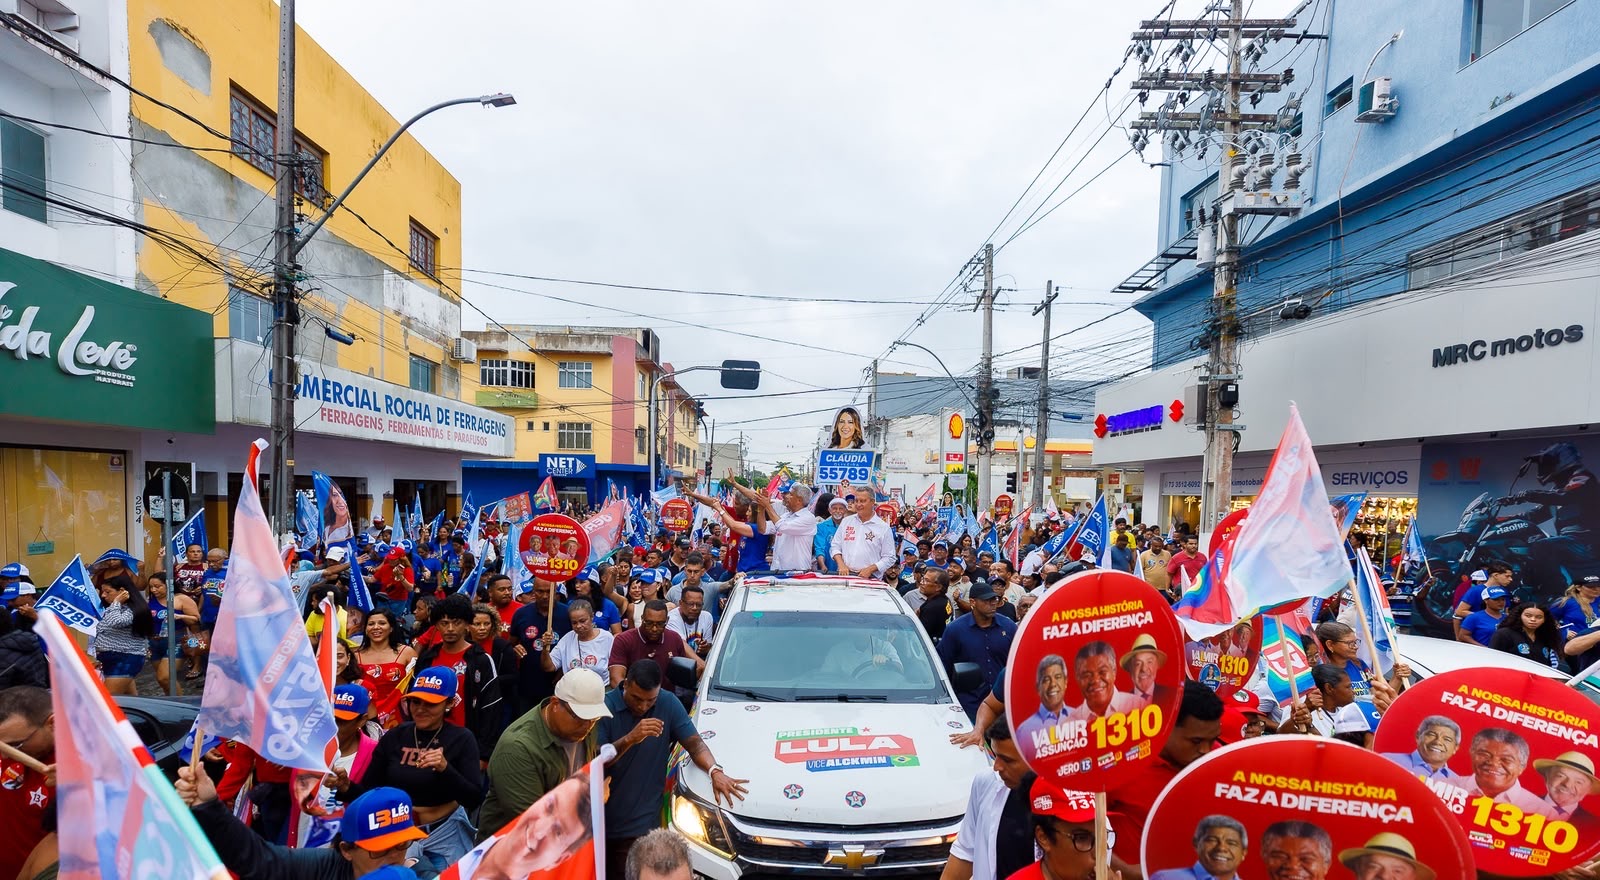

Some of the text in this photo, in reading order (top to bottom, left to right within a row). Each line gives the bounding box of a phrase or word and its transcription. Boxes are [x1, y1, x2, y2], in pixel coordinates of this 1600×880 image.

[1432, 324, 1584, 368] MRC motos
[95, 369, 136, 381] PRODUTOS
[95, 375, 134, 387] NATURAIS
[269, 369, 506, 438] MERCIAL ROCHA DE FERRAGENS
[321, 407, 488, 447] FERRAGENS, FERRAMENTAS E PARAFUSOS
[546, 456, 575, 468] NET
[825, 454, 868, 463] CLAUDIA
[546, 467, 574, 475] CENTER
[819, 467, 869, 480] 55789
[1332, 470, 1408, 489] SERVIÇOS
[548, 558, 578, 570] 1310
[46, 598, 95, 628] 55789
[1052, 600, 1144, 623] A NOSSA HISTÓRIA
[1042, 610, 1154, 640] FAZ A DIFERENÇA
[1191, 650, 1219, 664] VALMIR
[1220, 654, 1249, 677] 1310
[423, 682, 442, 690] BRITO
[425, 675, 443, 686] LÉO
[336, 692, 355, 702] LÉO
[1457, 684, 1589, 729] A NOSSA HISTÓRIA
[1090, 704, 1163, 749] 1310
[1440, 691, 1600, 748] FAZ A DIFERENÇA
[778, 727, 853, 738] PRESIDENTE
[1030, 719, 1088, 749] VALMIR
[779, 736, 902, 754] LULA
[1035, 737, 1088, 759] ASSUNÇÃO
[808, 756, 887, 768] VICE ALCKMIN
[1232, 770, 1397, 801] A NOSSA HISTÓRIA
[391, 803, 410, 818] LÉO
[1214, 783, 1415, 824] FAZ A DIFERENÇA
[1471, 796, 1579, 854] 1310
